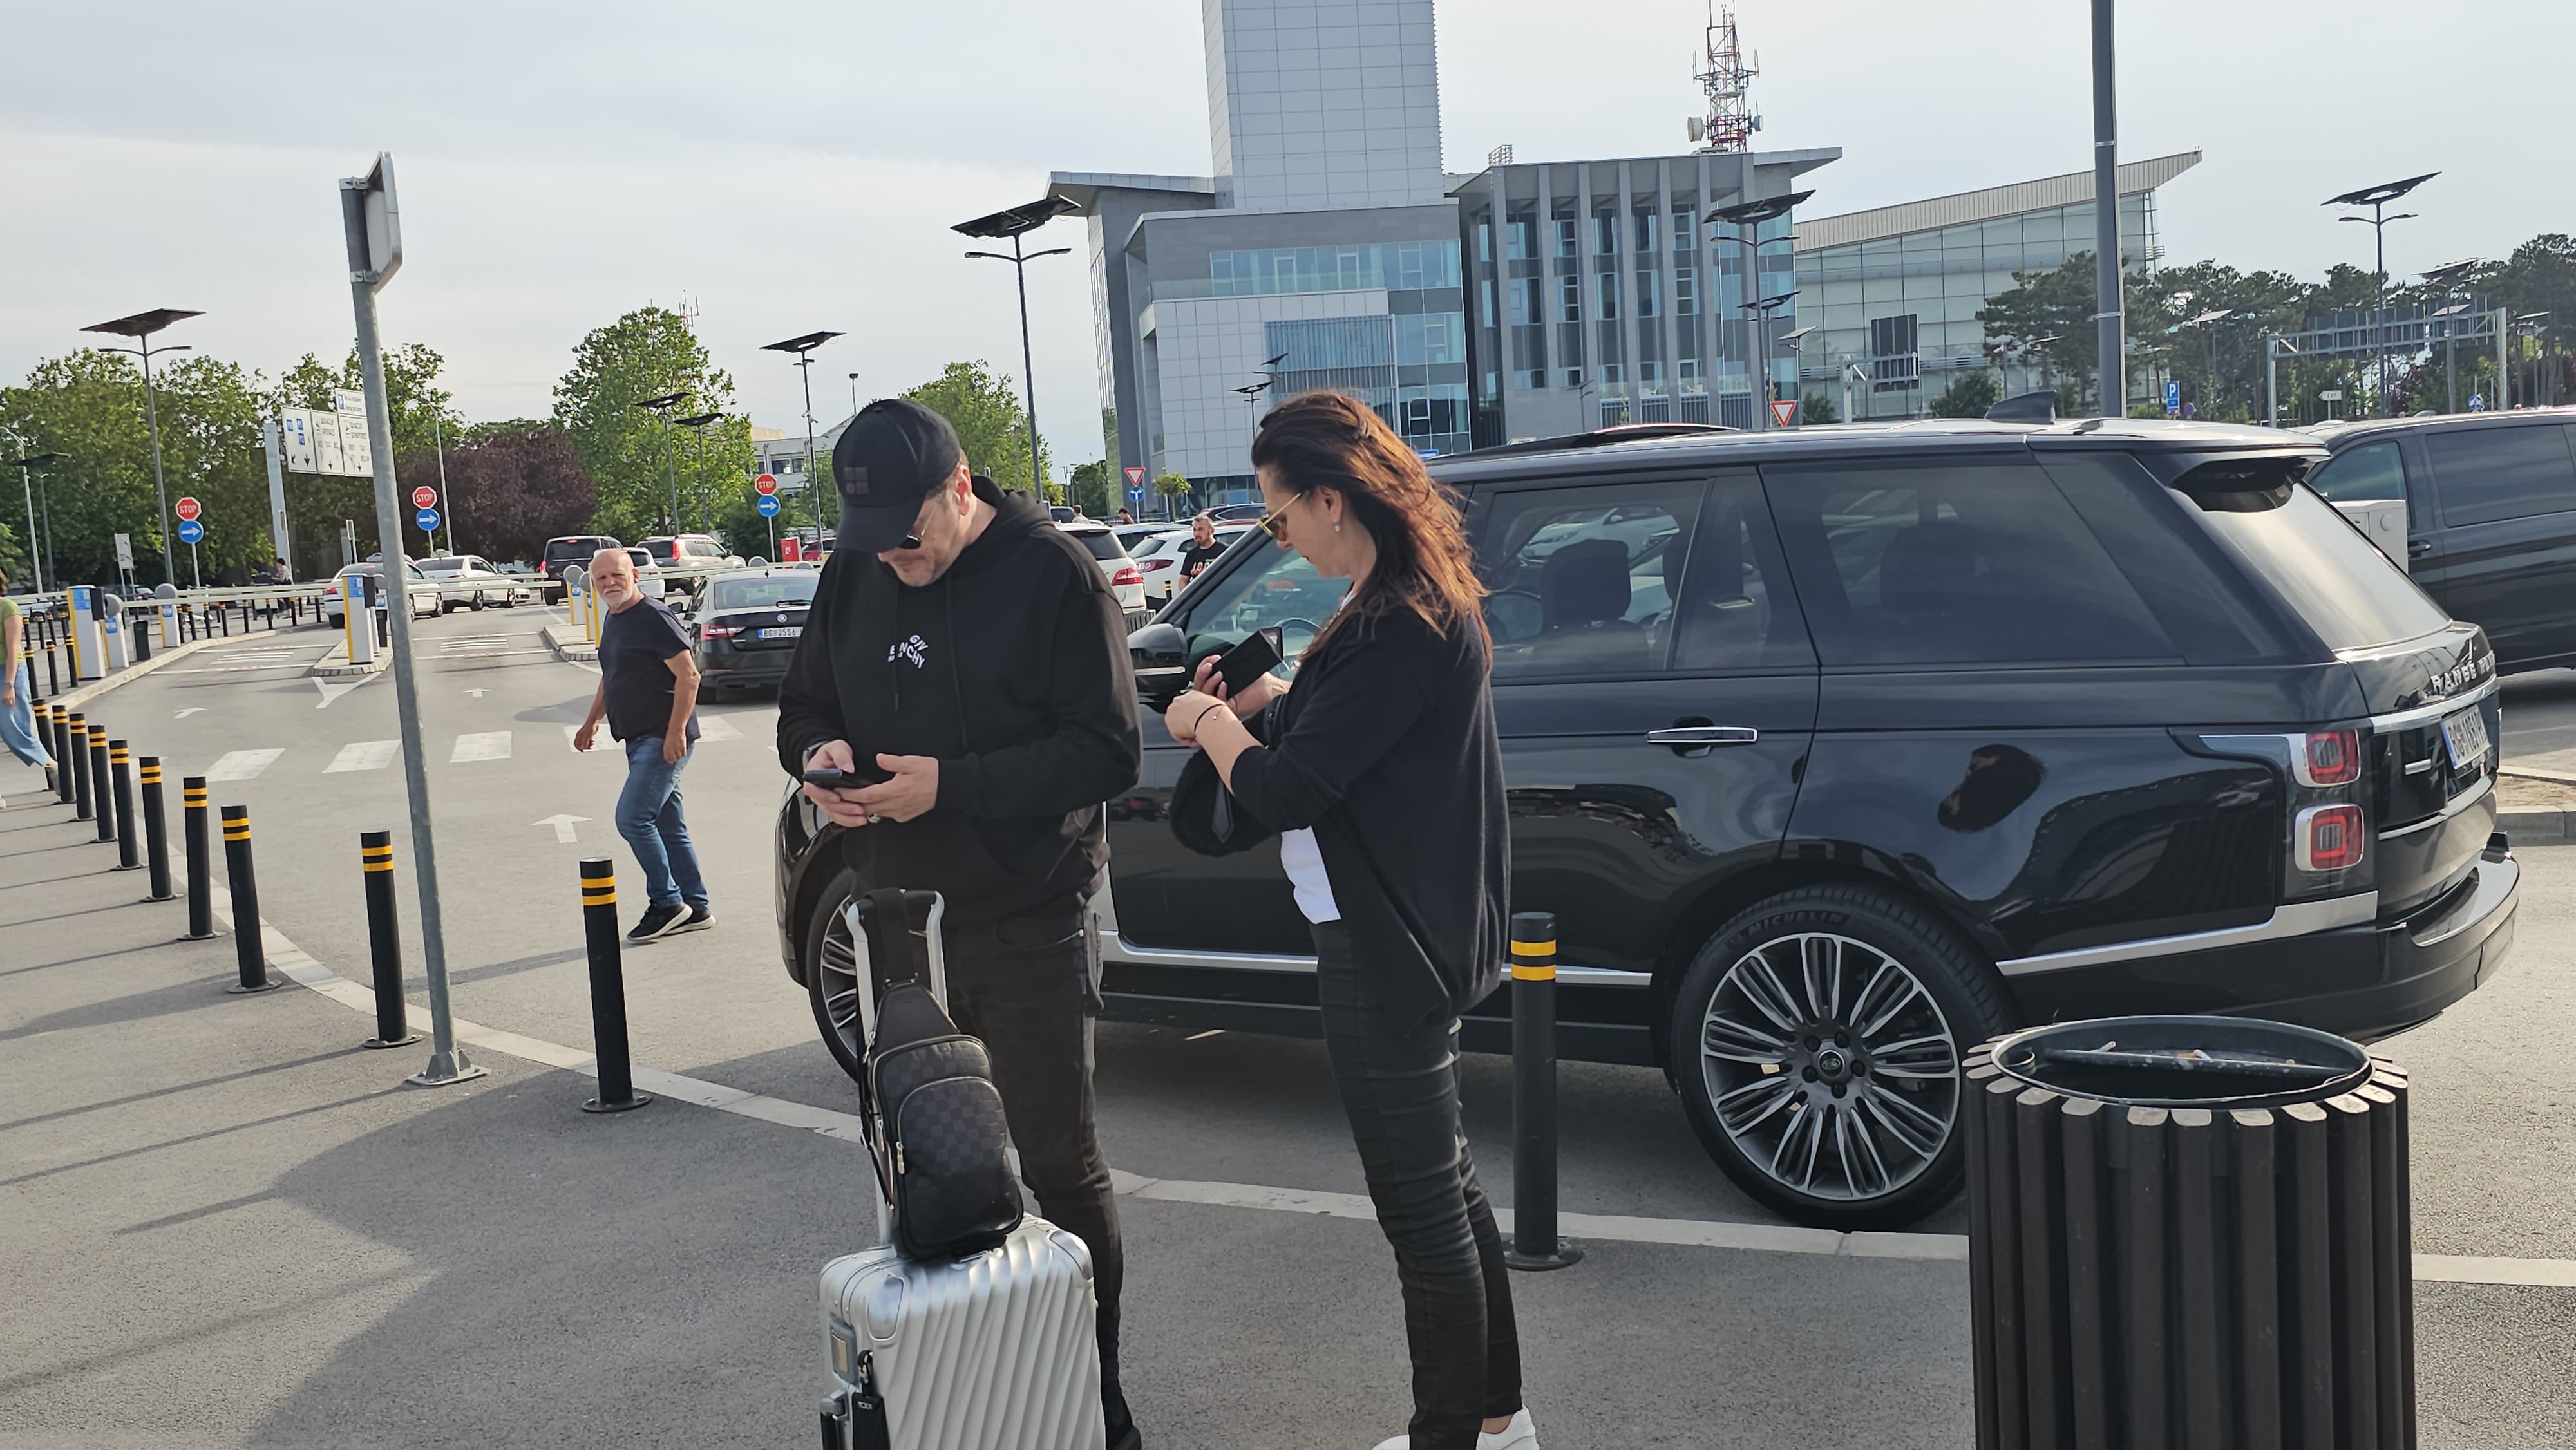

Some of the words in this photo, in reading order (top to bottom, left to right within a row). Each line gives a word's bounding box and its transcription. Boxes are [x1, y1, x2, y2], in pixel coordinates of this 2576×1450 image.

[2169, 383, 2176, 397] P
[758, 480, 775, 489] STOP
[416, 493, 433, 502] STOP
[179, 504, 197, 514] STOP
[909, 634, 929, 651] GIV
[2430, 663, 2477, 695] RANGE
[1748, 911, 1844, 936] MICHELIN
